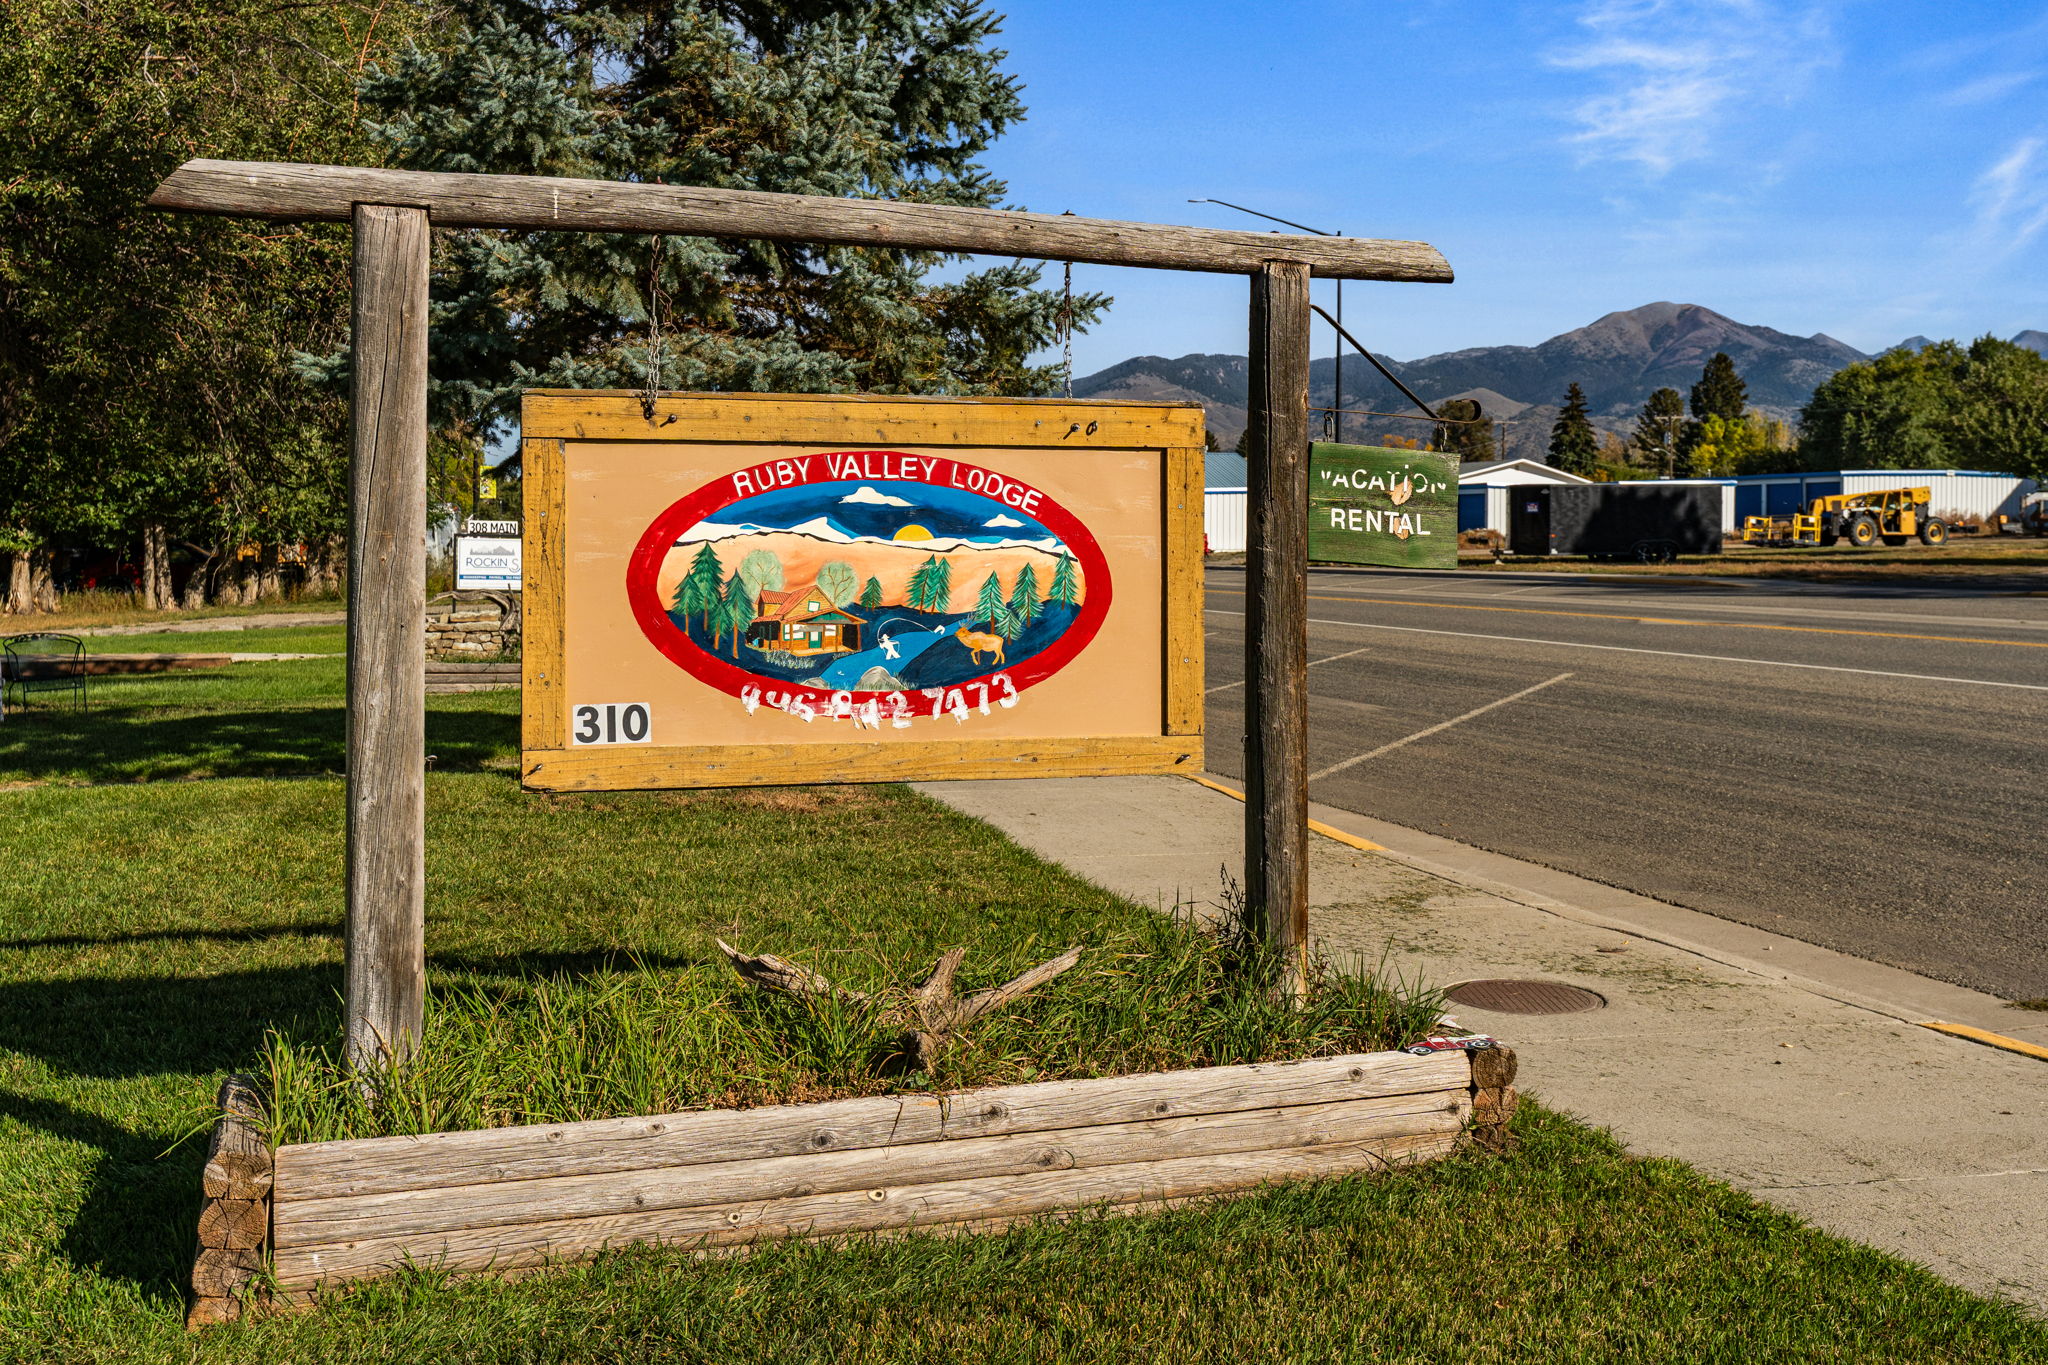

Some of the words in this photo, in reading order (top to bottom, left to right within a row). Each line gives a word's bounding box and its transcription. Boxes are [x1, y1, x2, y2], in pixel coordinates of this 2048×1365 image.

[732, 456, 813, 498] RUBY
[825, 454, 938, 481] VALLEY
[951, 463, 1044, 516] LODGE
[470, 522, 487, 533] 308
[490, 522, 517, 534] MAIN
[1330, 508, 1431, 535] RENTAL
[466, 558, 507, 567] ROCKIN
[575, 704, 648, 743] 310
